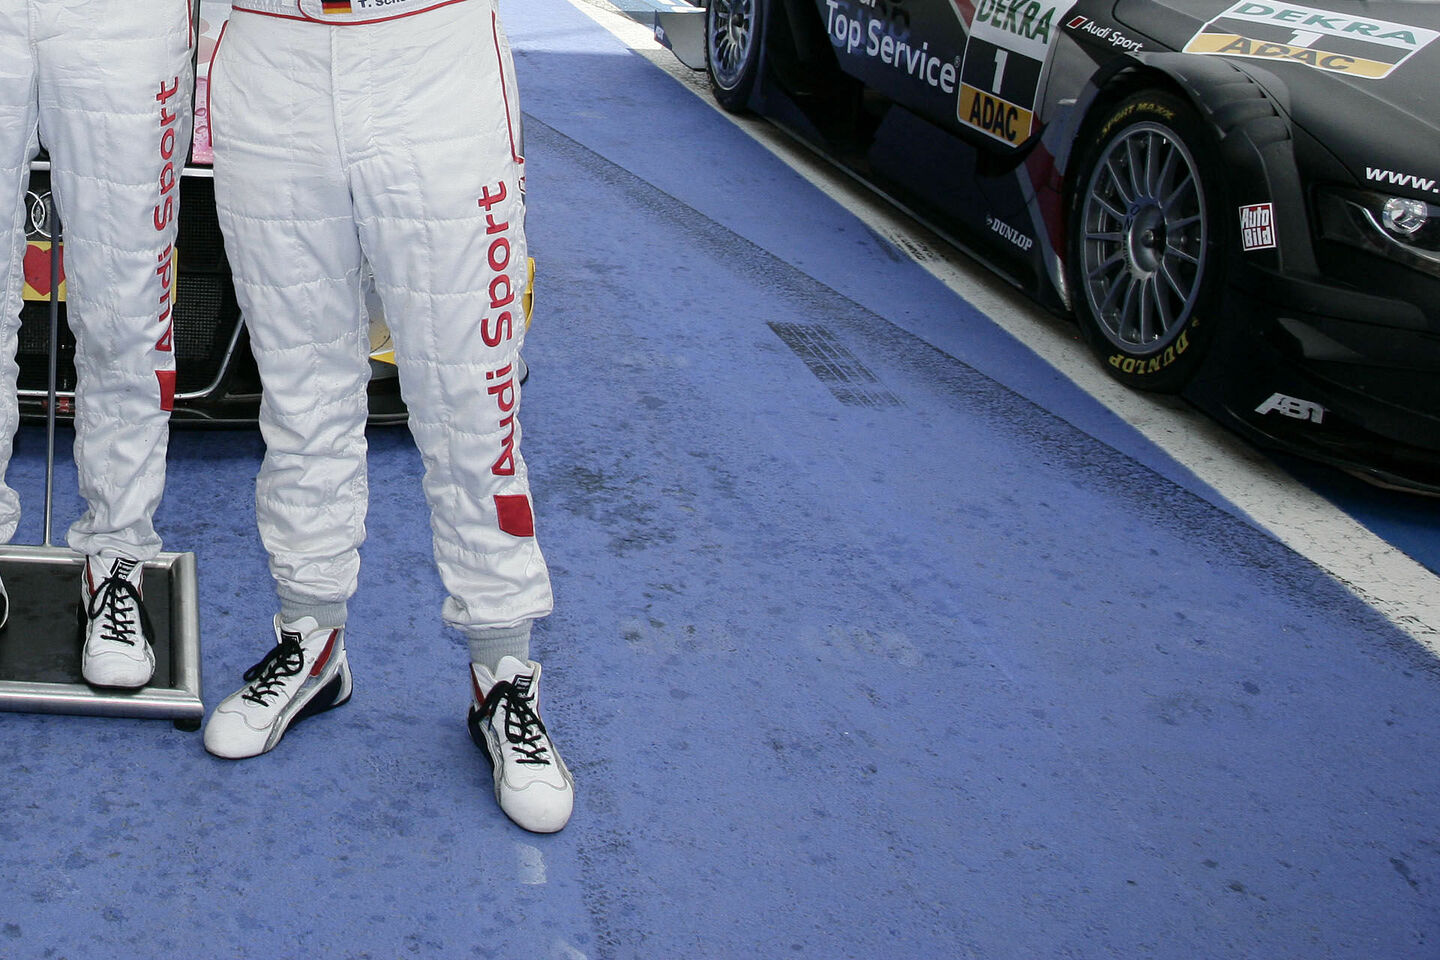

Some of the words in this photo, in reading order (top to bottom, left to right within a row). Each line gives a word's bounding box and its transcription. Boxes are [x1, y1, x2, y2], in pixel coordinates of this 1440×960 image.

[357, 0, 372, 9] T.
[826, 0, 861, 54] Top
[1082, 21, 1110, 39] Audi
[1108, 33, 1143, 53] Sport
[1233, 2, 1417, 46] DEKRA
[1286, 29, 1325, 48] 1
[992, 48, 1009, 95] 1
[1216, 37, 1356, 71] ADAC
[969, 92, 1018, 141] ADAC
[154, 76, 179, 232] Sport
[1365, 166, 1440, 194] www.
[991, 218, 1033, 252] DUNLOP
[1242, 207, 1271, 228] Auto
[1243, 227, 1272, 248] Bild
[477, 180, 514, 349] Sport
[155, 241, 174, 352] Audi
[1109, 336, 1190, 376] DUNLOP
[486, 362, 516, 476] Audi
[1254, 392, 1333, 425] ABT
